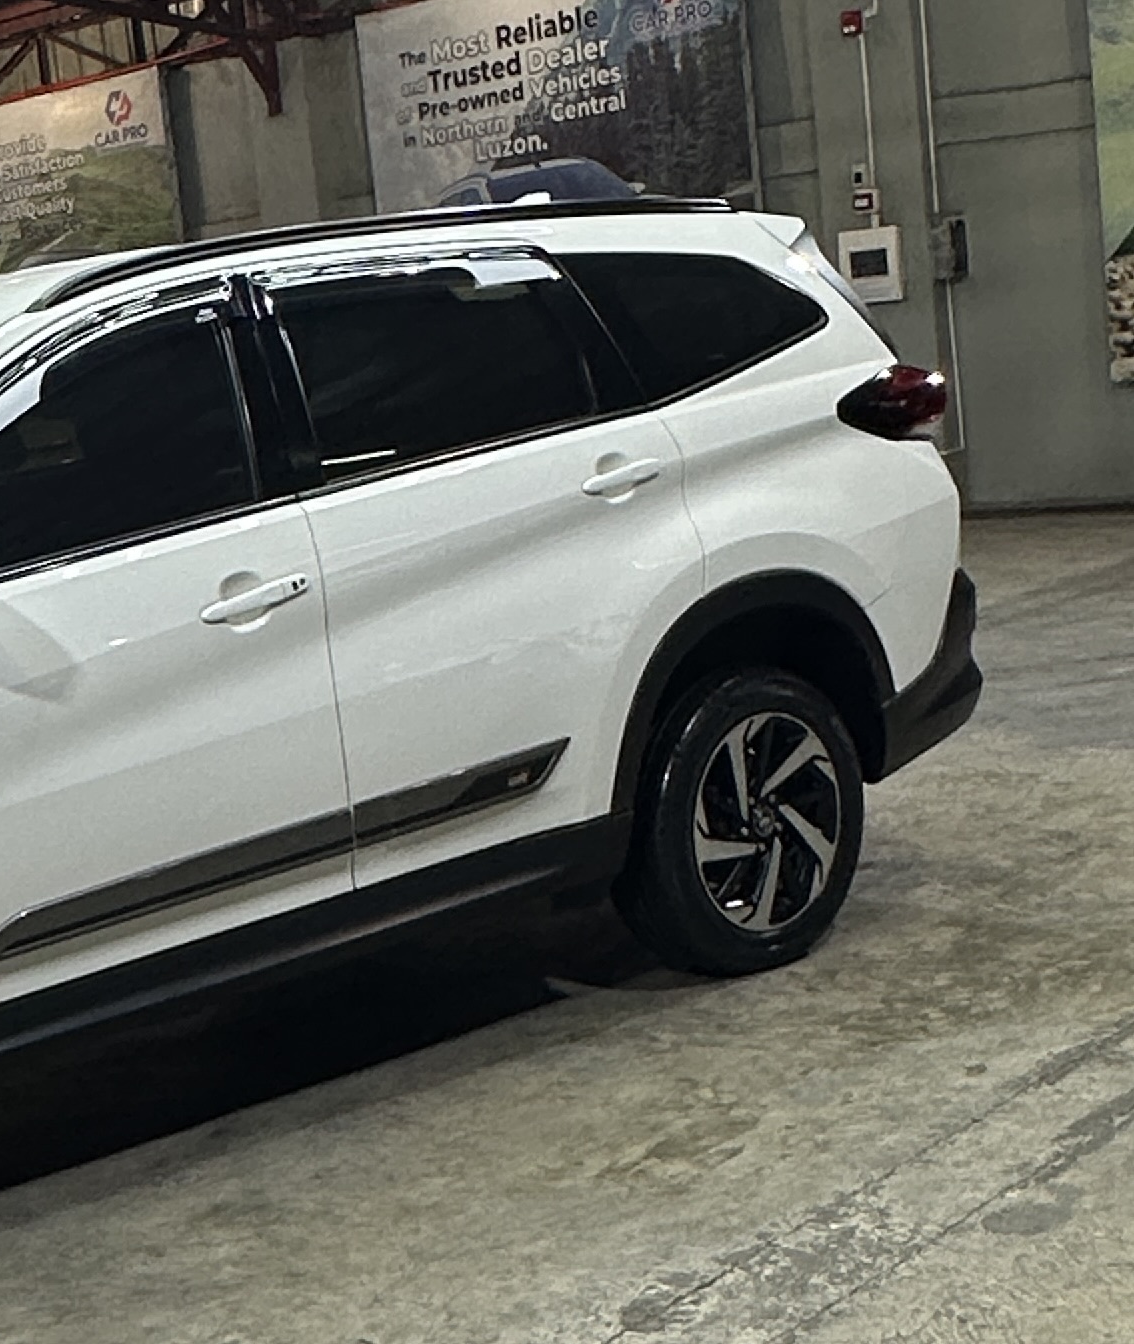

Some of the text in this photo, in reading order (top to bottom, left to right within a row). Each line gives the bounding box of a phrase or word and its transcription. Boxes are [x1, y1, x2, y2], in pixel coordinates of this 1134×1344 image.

[398, 6, 599, 68] The Most Reliable
[632, 0, 712, 33] CAR PRO
[427, 51, 522, 93] Trusted
[526, 36, 610, 76] Dealer
[402, 132, 417, 148] in
[421, 115, 509, 148] Northern
[550, 89, 627, 123] Central
[418, 81, 524, 121] Pre-owned
[529, 65, 622, 99] Vehicles
[1, 152, 85, 182] Satisfaction
[474, 132, 549, 162] Luzon.
